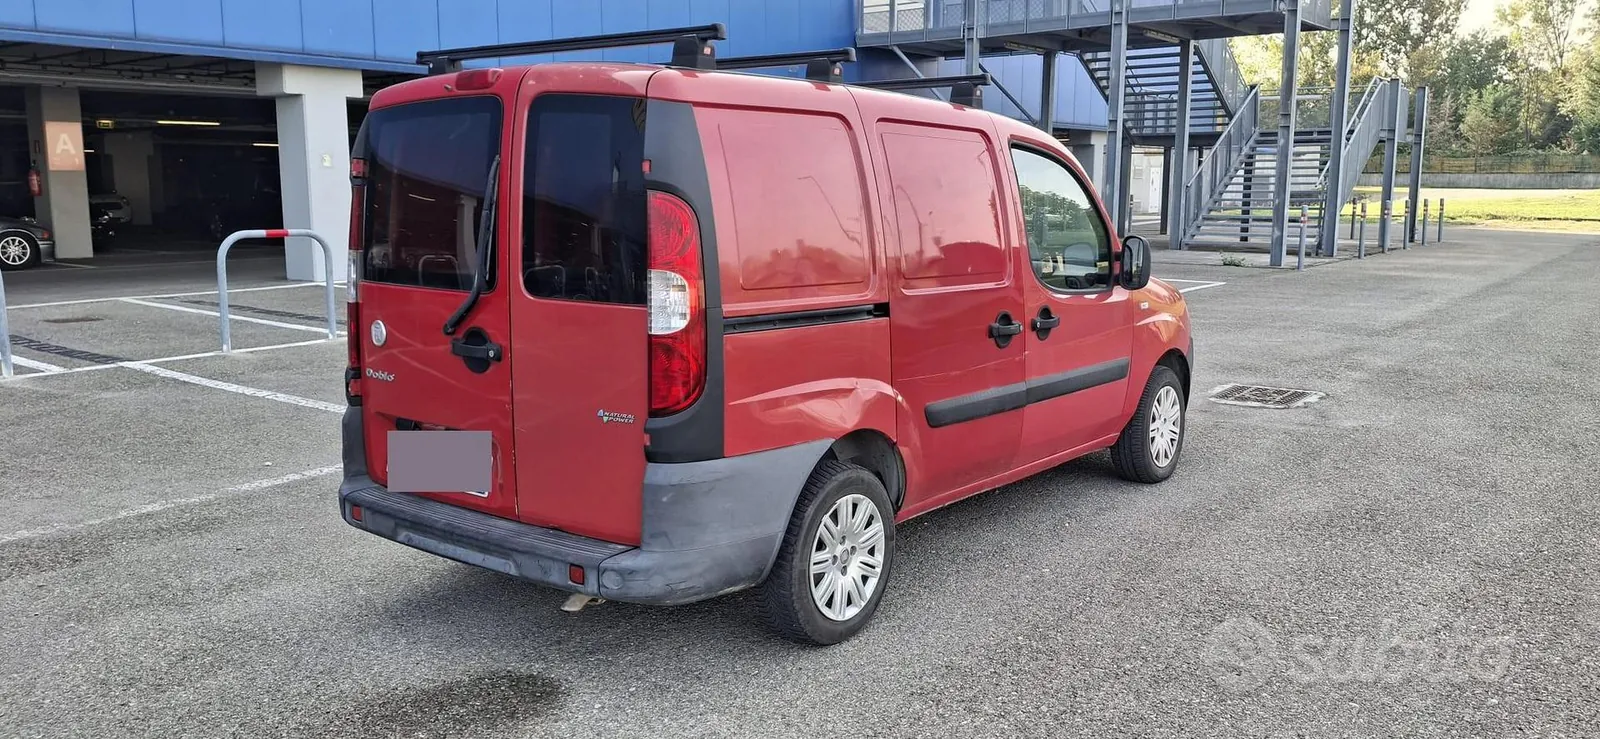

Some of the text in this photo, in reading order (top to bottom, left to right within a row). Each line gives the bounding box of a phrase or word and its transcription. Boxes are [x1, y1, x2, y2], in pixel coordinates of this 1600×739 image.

[56, 133, 76, 155] A
[604, 411, 635, 420] NATURAL
[608, 416, 634, 424] POWER
